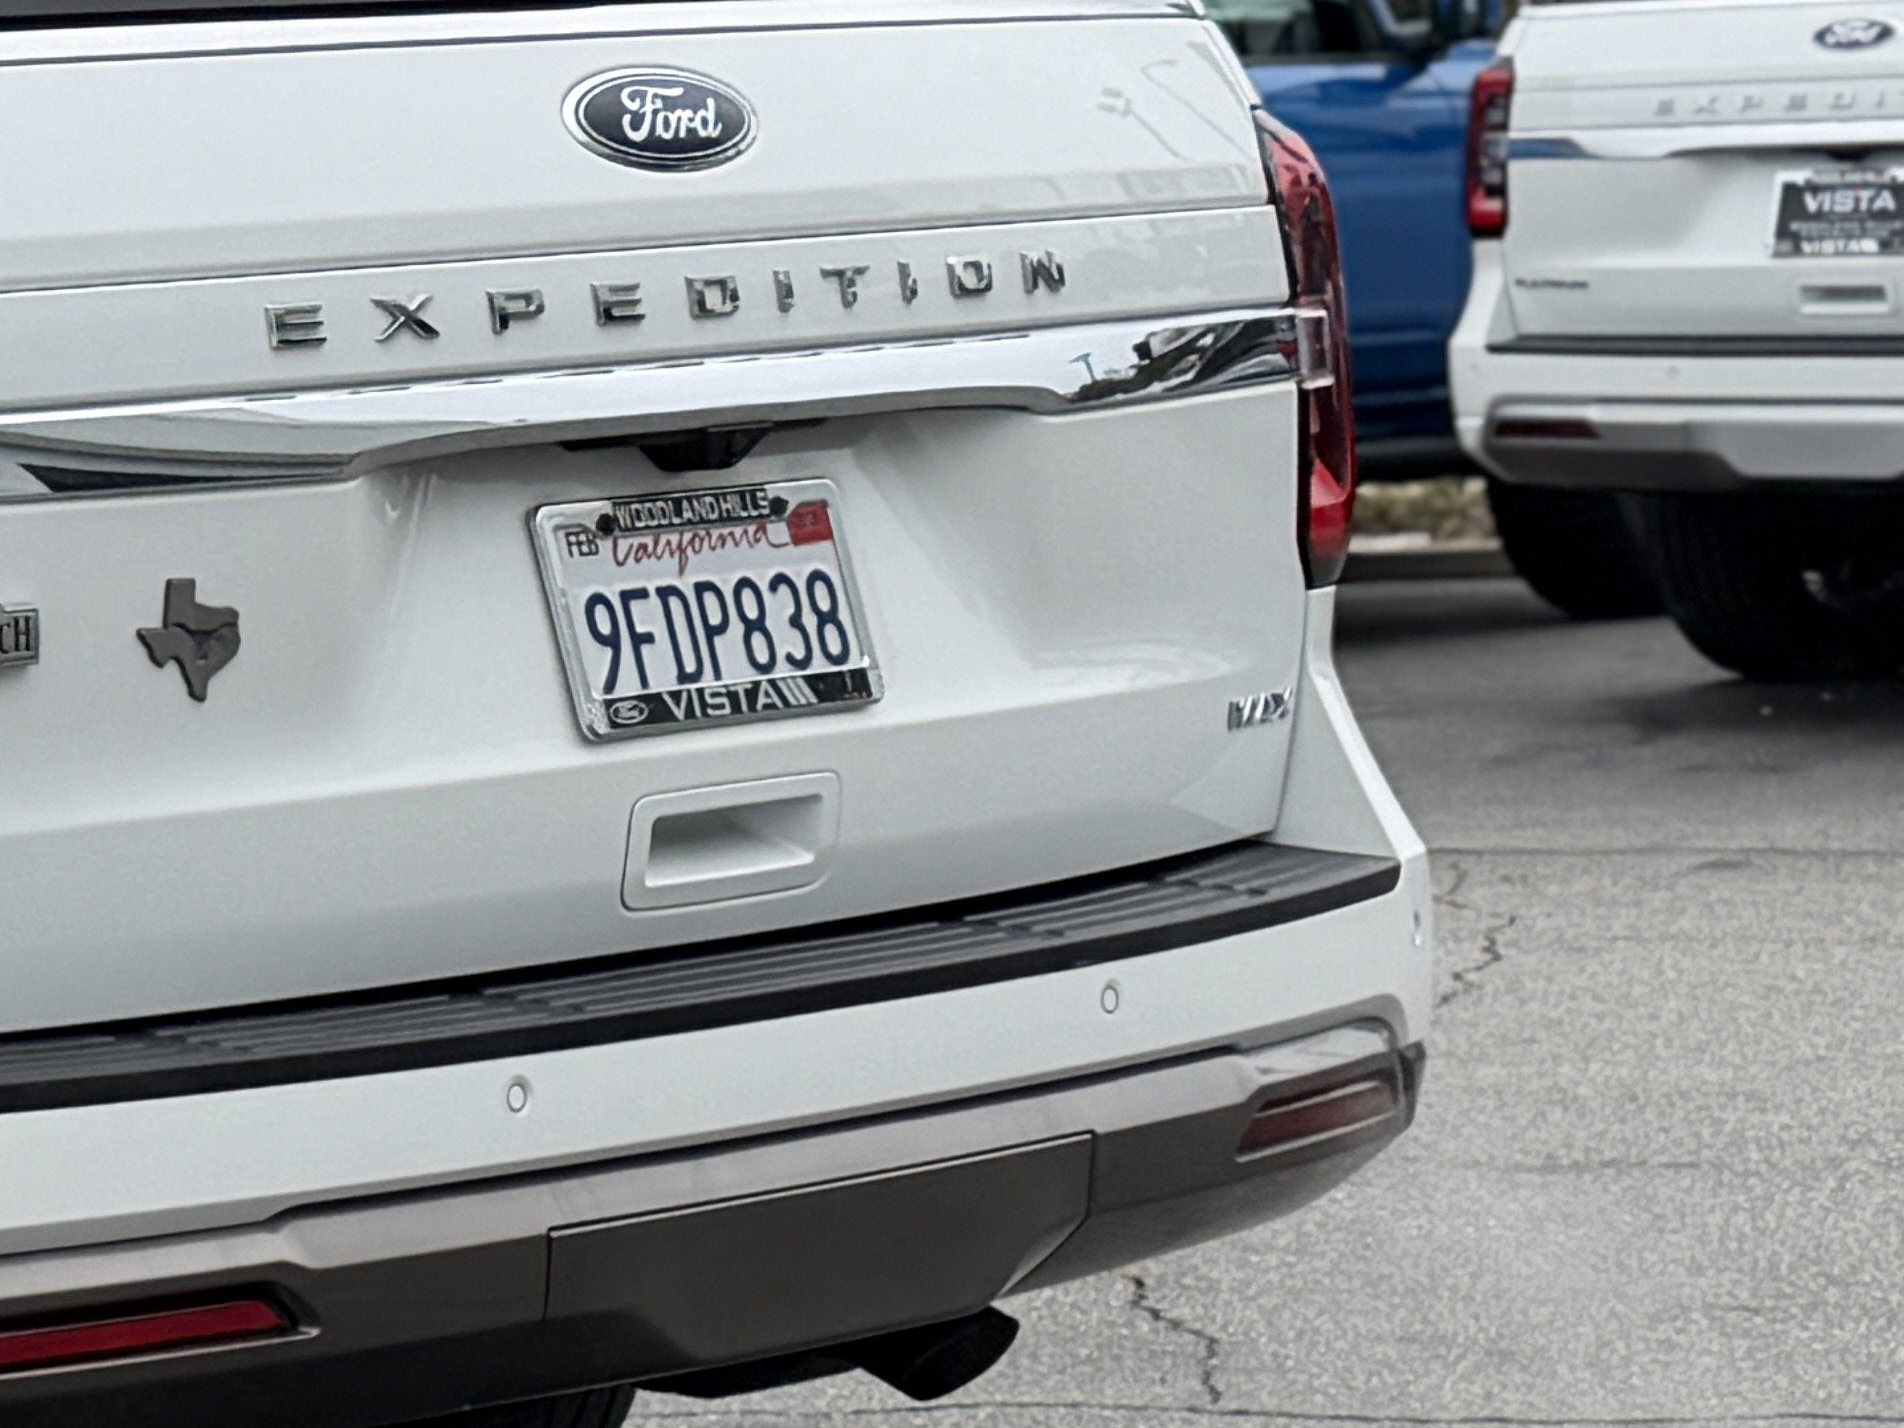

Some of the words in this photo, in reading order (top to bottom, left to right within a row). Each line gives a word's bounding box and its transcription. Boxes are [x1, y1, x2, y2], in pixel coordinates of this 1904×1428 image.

[621, 85, 722, 143] Ford
[1804, 189, 1896, 214] VISTA
[264, 249, 1066, 350] EXPEDITION
[614, 495, 719, 529] WOODLAND
[719, 489, 771, 519] HILLS
[565, 529, 600, 559] FEB
[612, 520, 789, 578] California
[585, 567, 851, 695] 9FDP838
[662, 678, 785, 721] VISTA
